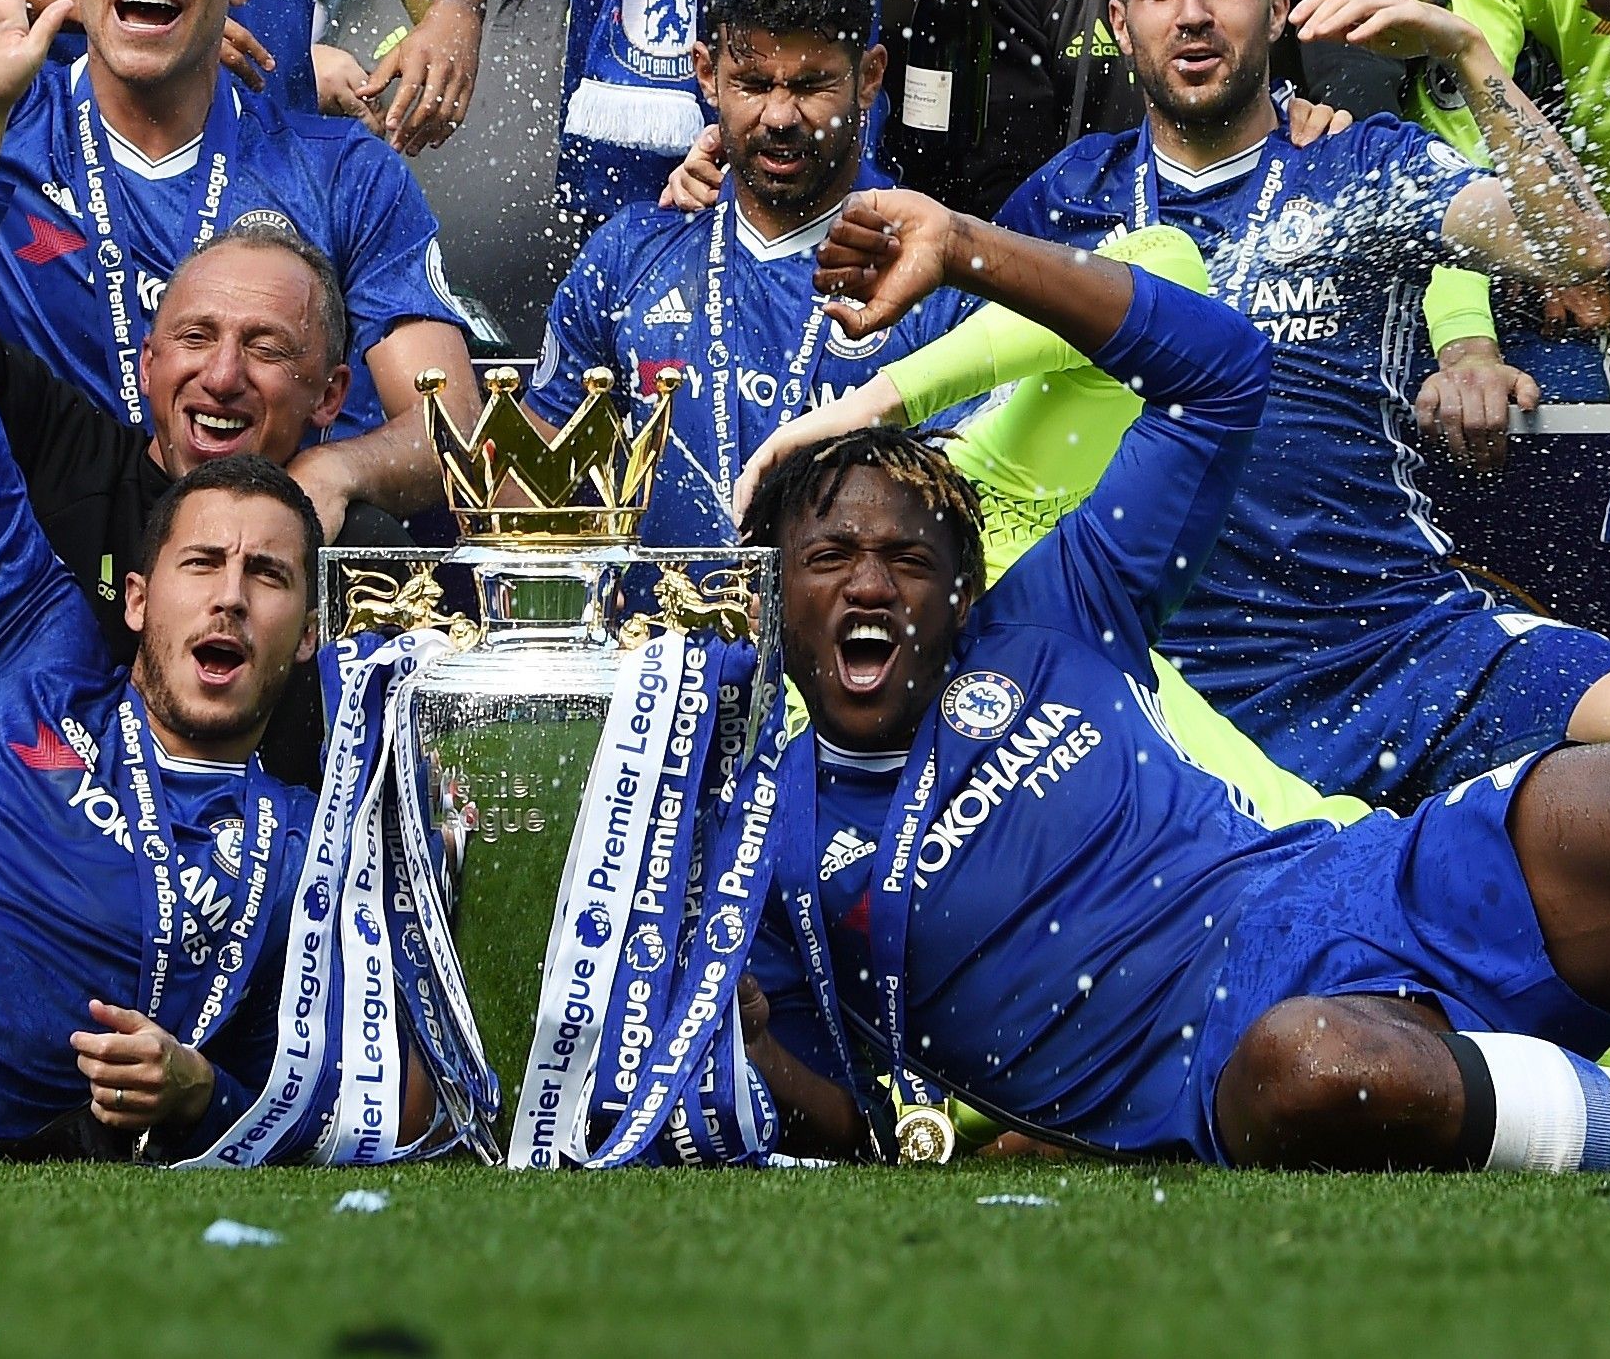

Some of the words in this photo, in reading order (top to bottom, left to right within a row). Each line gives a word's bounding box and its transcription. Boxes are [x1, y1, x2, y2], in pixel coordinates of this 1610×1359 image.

[77, 99, 100, 169] Premier
[86, 165, 112, 236] League
[197, 153, 229, 219] League
[239, 211, 289, 231] CHELSEA
[1247, 159, 1285, 222] League
[708, 201, 729, 265] Premier
[106, 270, 132, 346] Premier
[643, 309, 693, 326] adidas
[705, 266, 726, 337] League
[789, 306, 827, 376] Premier
[118, 347, 143, 425] League
[712, 369, 732, 442] Premier
[715, 441, 736, 504] Leagu
[118, 700, 142, 768] League
[944, 676, 977, 717] CHELSEA
[587, 761, 642, 893] Premier
[615, 642, 669, 756] League
[633, 783, 684, 914] Premier
[660, 645, 710, 778] League
[913, 699, 1083, 891] YOKOHAMA
[1022, 720, 1103, 800] TYRES
[129, 765, 160, 832] Premier
[316, 738, 351, 868] Premier
[716, 771, 777, 899] Premier
[230, 866, 268, 939] Premier
[249, 796, 279, 863] League
[818, 840, 877, 882] adidas
[883, 815, 920, 893] Premier
[153, 865, 178, 944] League
[796, 892, 825, 977] Premier
[147, 948, 171, 1019] remier
[355, 954, 388, 1085] League
[537, 958, 596, 1074] League
[651, 960, 728, 1076] League
[218, 1066, 304, 1166] Premier
[287, 930, 322, 1060] League
[601, 979, 654, 1113] League
[351, 1092, 384, 1164] mier
[529, 1079, 561, 1169] emier
